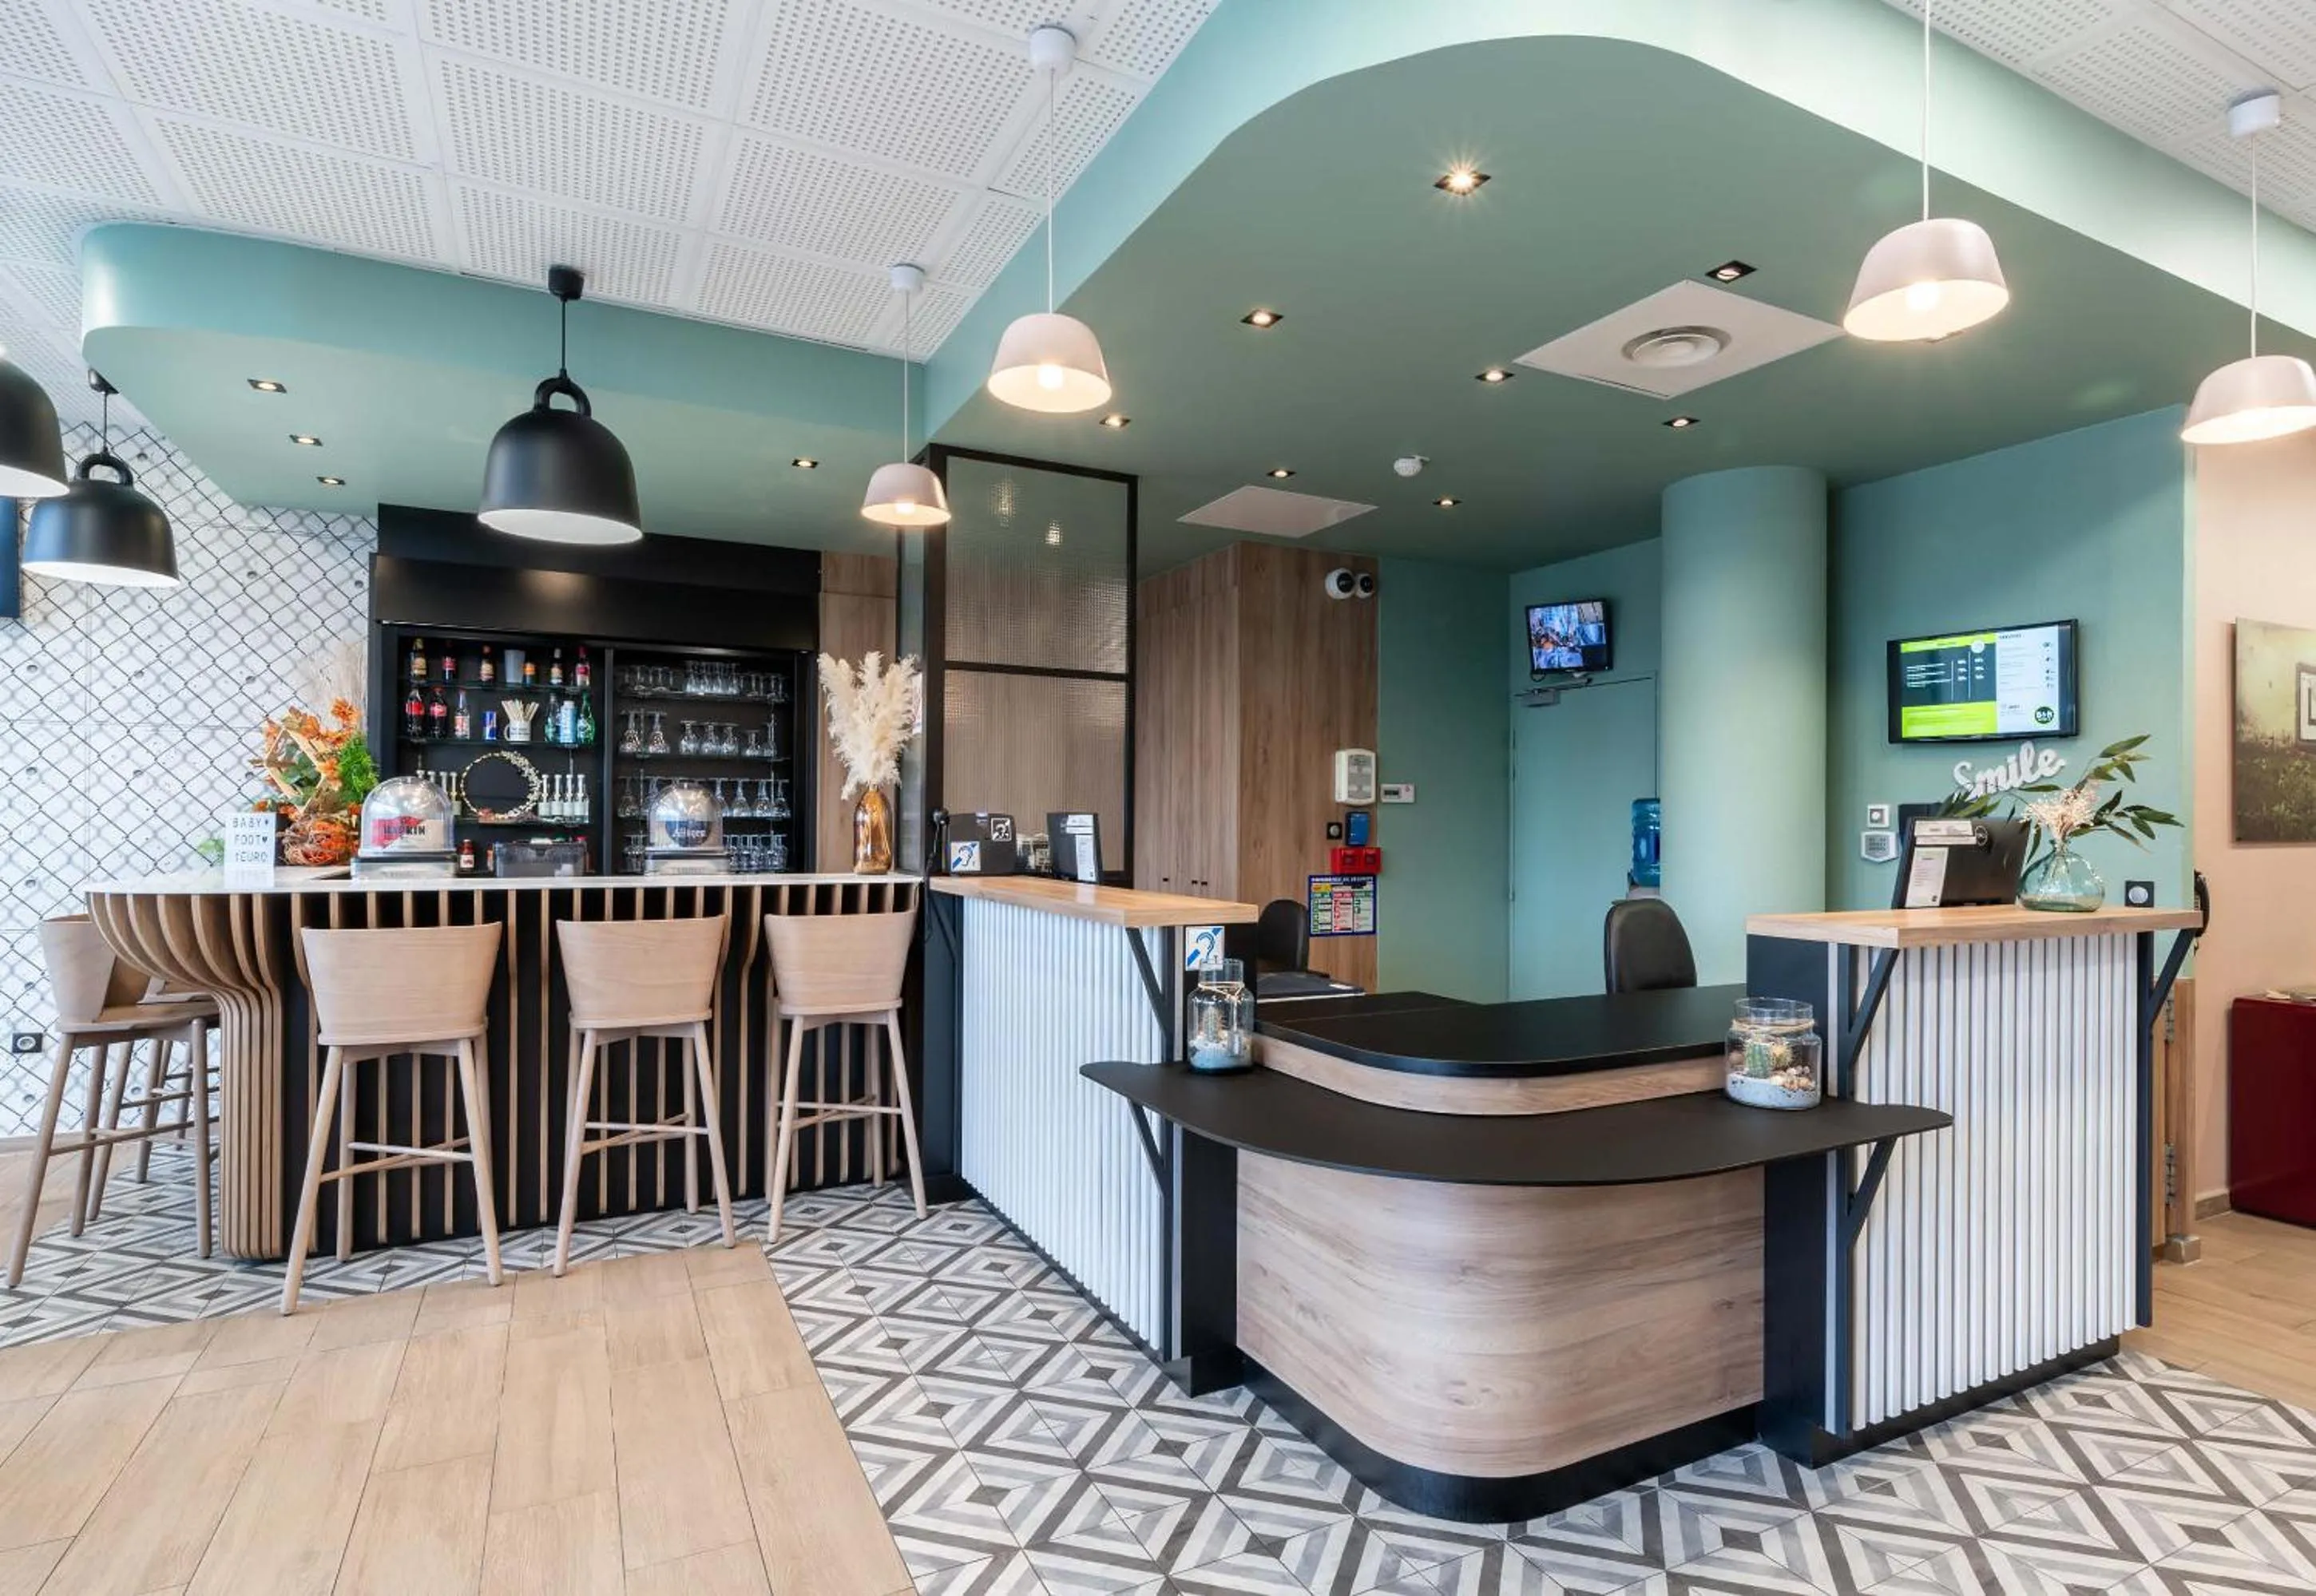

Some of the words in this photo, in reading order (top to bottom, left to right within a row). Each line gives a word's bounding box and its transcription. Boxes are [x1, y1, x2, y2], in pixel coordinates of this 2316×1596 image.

[1953, 740, 2067, 800] Smile
[232, 818, 262, 828] BABY
[234, 834, 261, 845] FOOT
